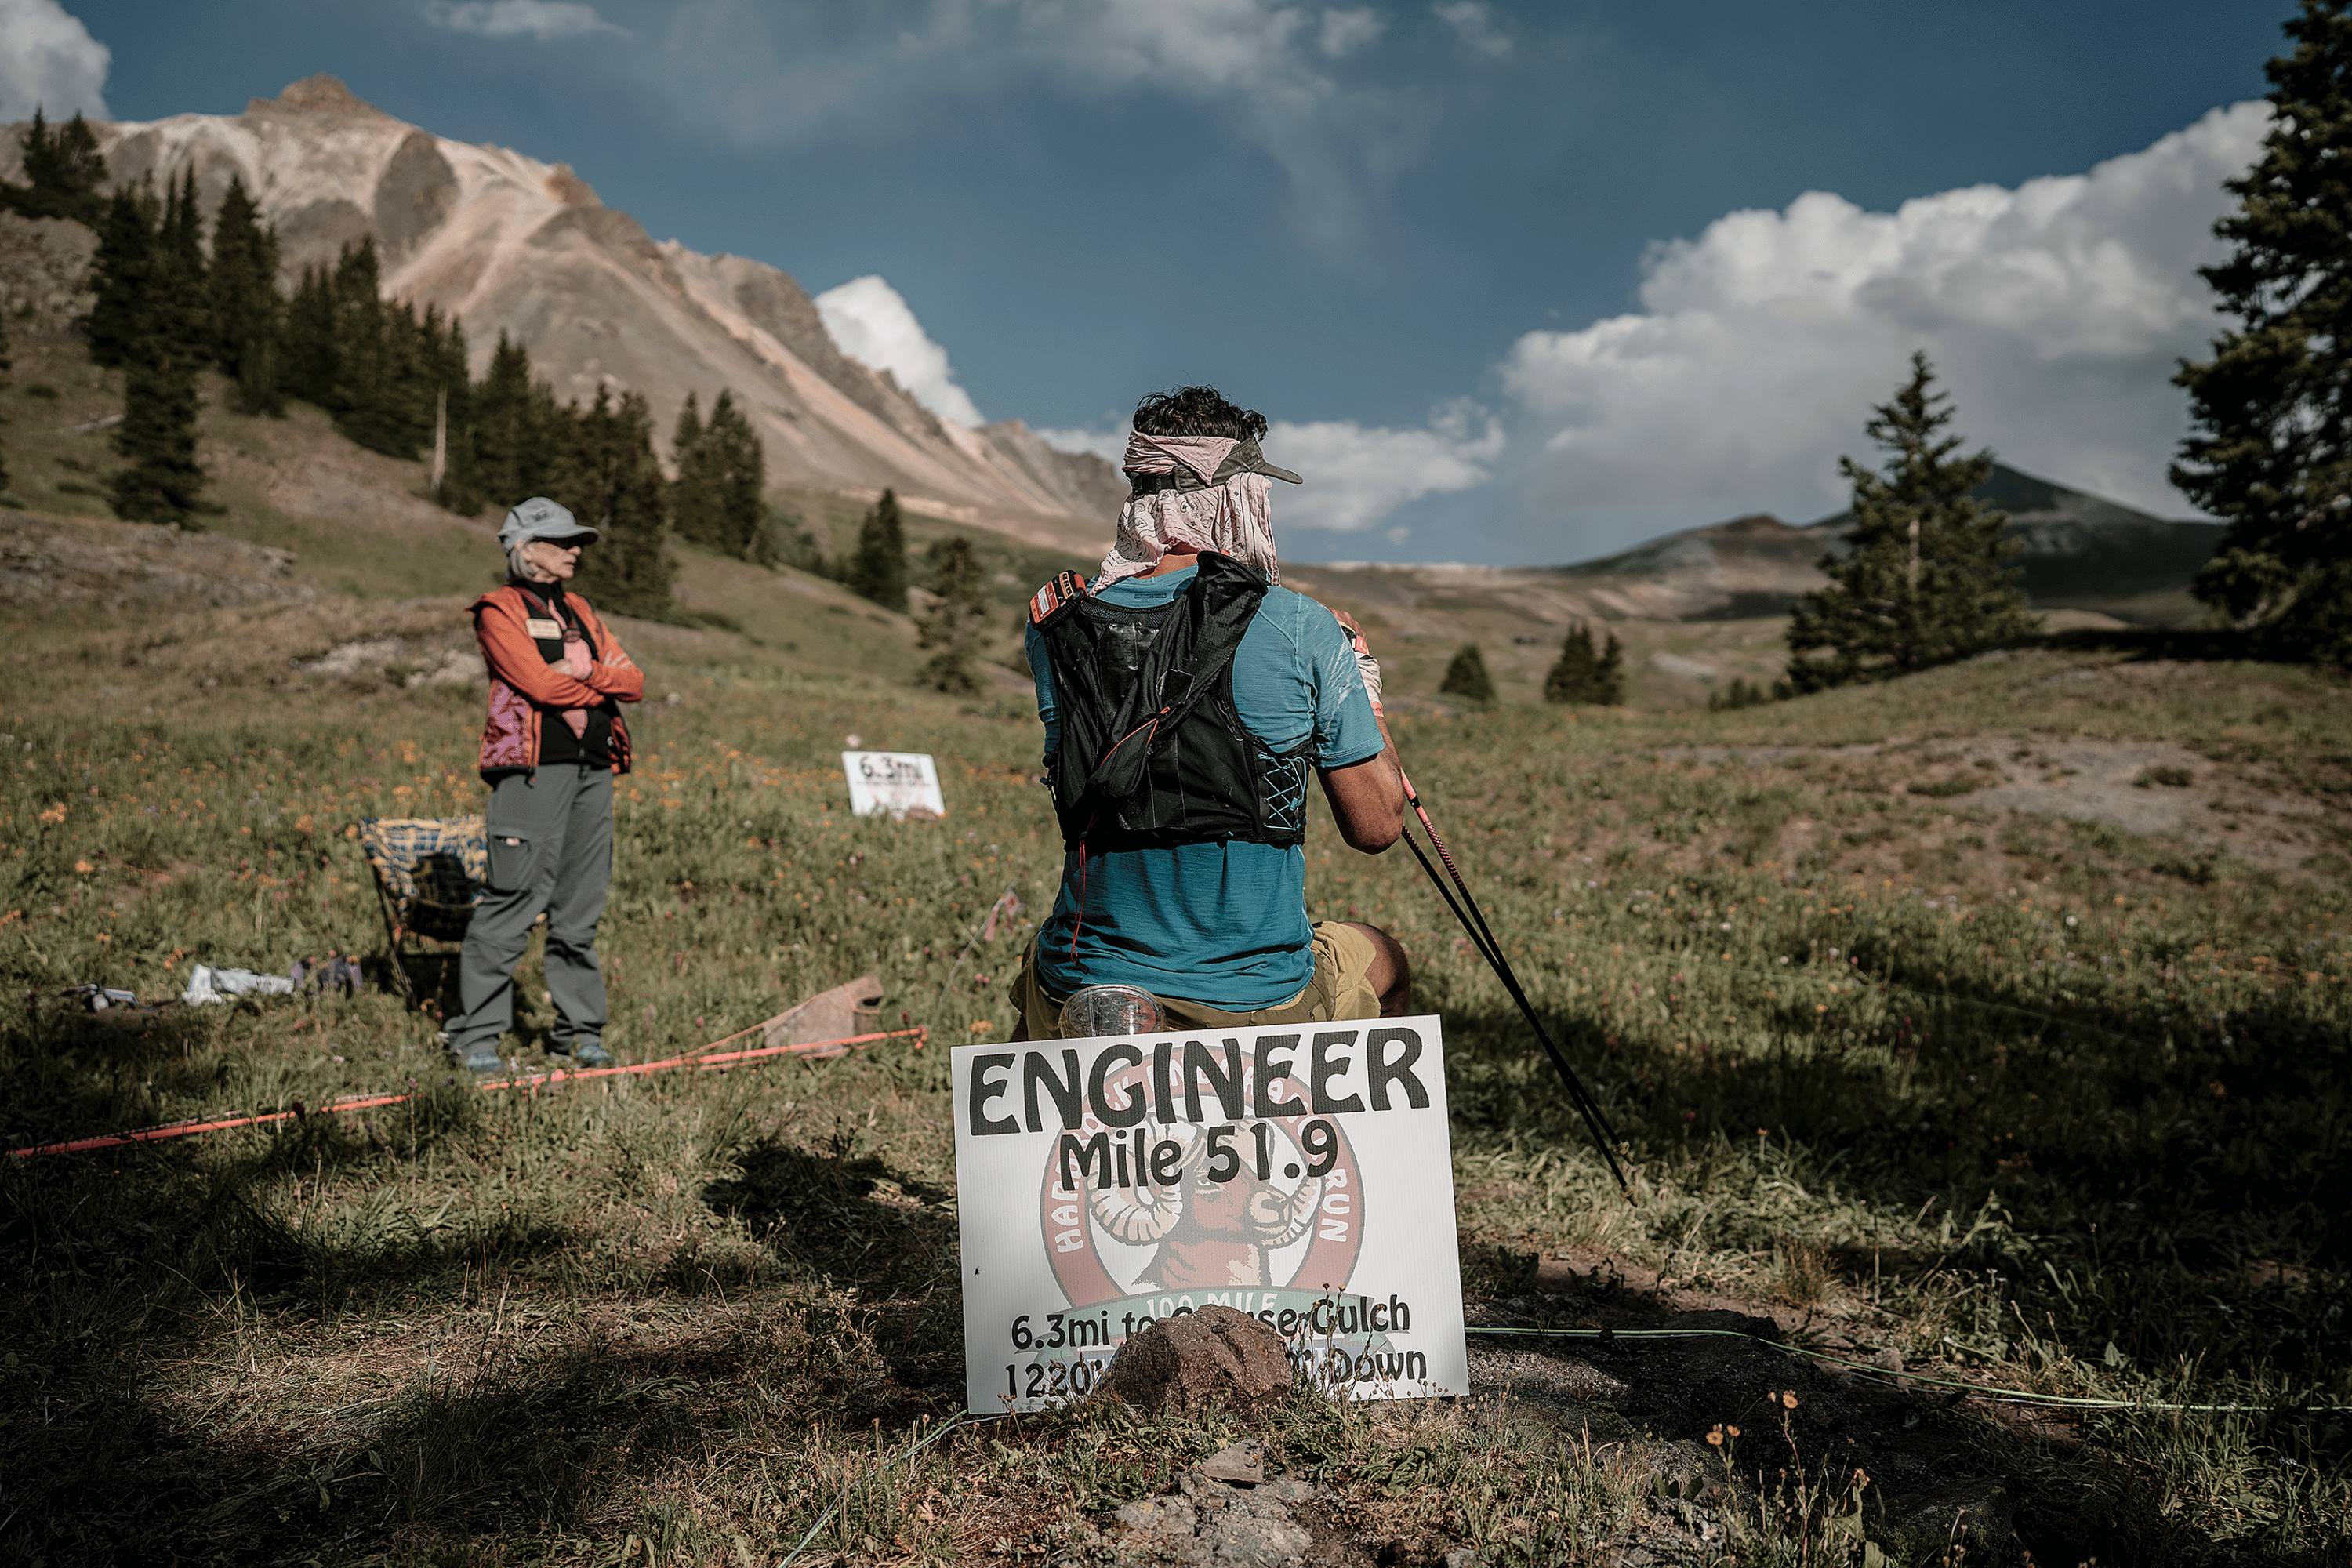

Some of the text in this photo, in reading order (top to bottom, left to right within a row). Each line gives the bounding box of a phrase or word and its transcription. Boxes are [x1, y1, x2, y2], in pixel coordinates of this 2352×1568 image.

[969, 1026, 1430, 1136] ENGINEER
[1060, 1119, 1338, 1191] Mile 51.9
[1319, 1168, 1351, 1243] RUN
[1011, 1310, 1110, 1350] 6.3mi
[1311, 1294, 1410, 1335] Gulch
[1328, 1348, 1427, 1384] Down
